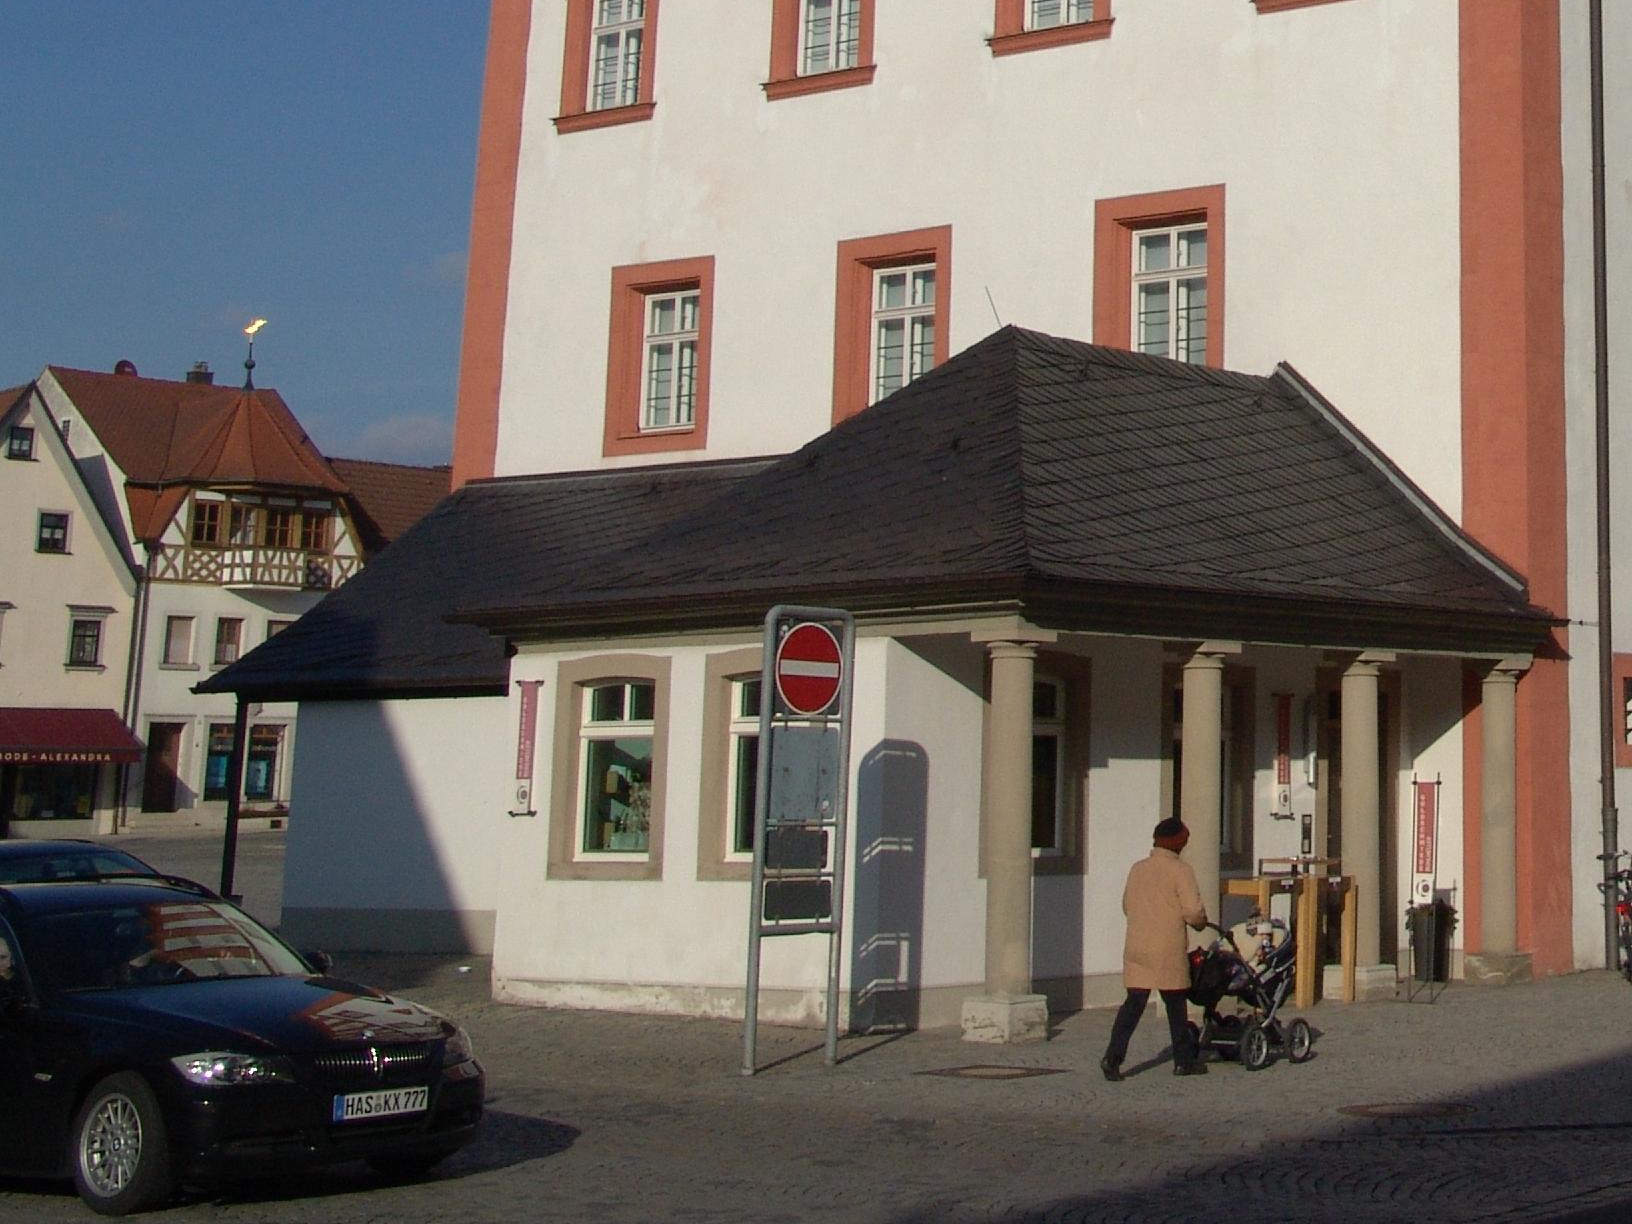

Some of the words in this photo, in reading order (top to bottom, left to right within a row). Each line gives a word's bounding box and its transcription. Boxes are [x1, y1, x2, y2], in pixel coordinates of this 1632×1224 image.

[40, 752, 111, 761] ALEXANDRA
[345, 1096, 373, 1116] HAS
[383, 1093, 401, 1112] KX
[404, 1090, 426, 1109] 777
